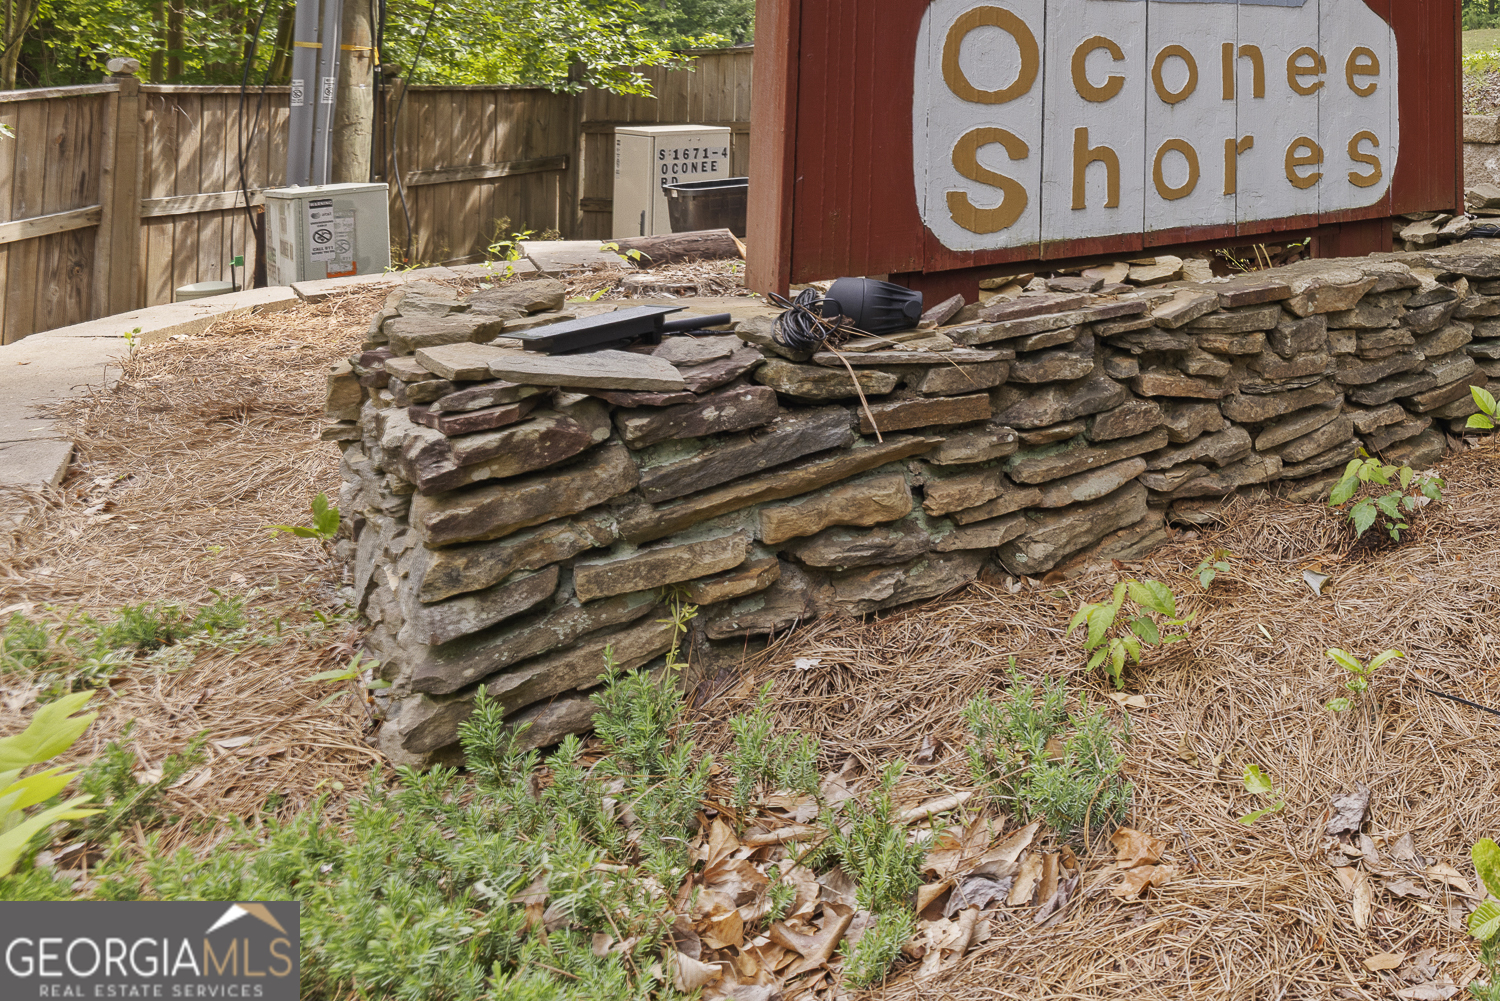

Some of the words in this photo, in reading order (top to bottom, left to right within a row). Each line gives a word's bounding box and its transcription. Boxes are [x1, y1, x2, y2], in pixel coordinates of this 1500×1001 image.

[942, 5, 1380, 104] Oconee
[661, 161, 718, 175] OCONEE
[946, 127, 1382, 234] Shores
